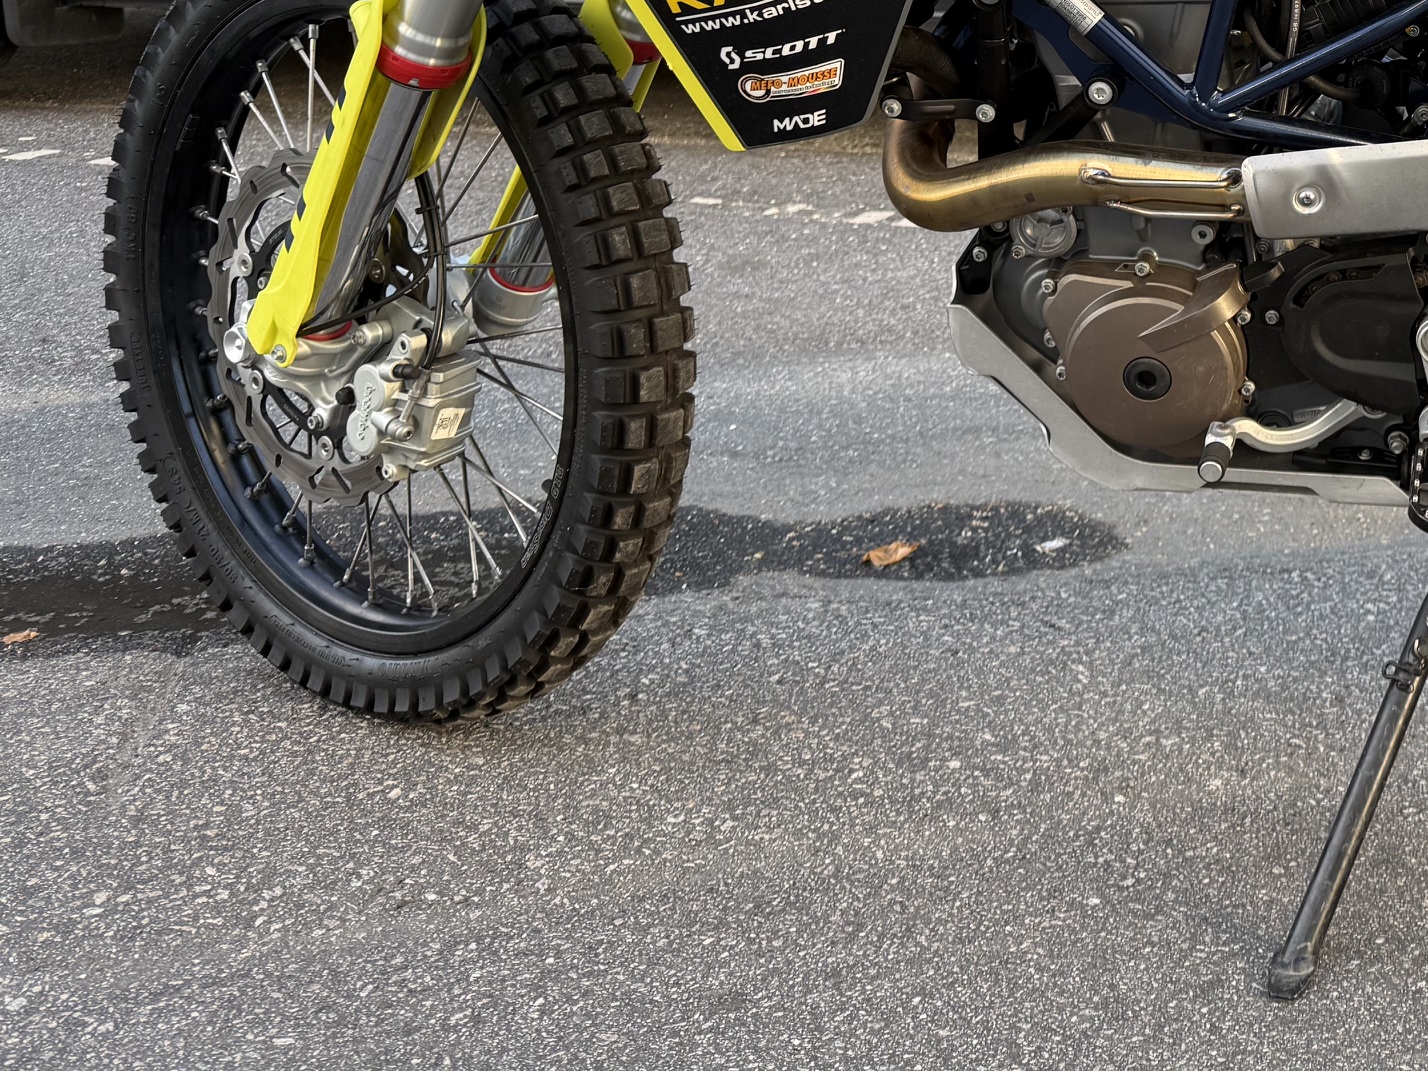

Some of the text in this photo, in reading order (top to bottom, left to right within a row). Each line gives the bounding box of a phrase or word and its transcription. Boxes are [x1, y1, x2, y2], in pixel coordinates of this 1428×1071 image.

[743, 29, 843, 62] SCOTT
[749, 67, 839, 92] MEFO-MOUSSE
[772, 109, 827, 133] MADE
[356, 382, 376, 442] brembo
